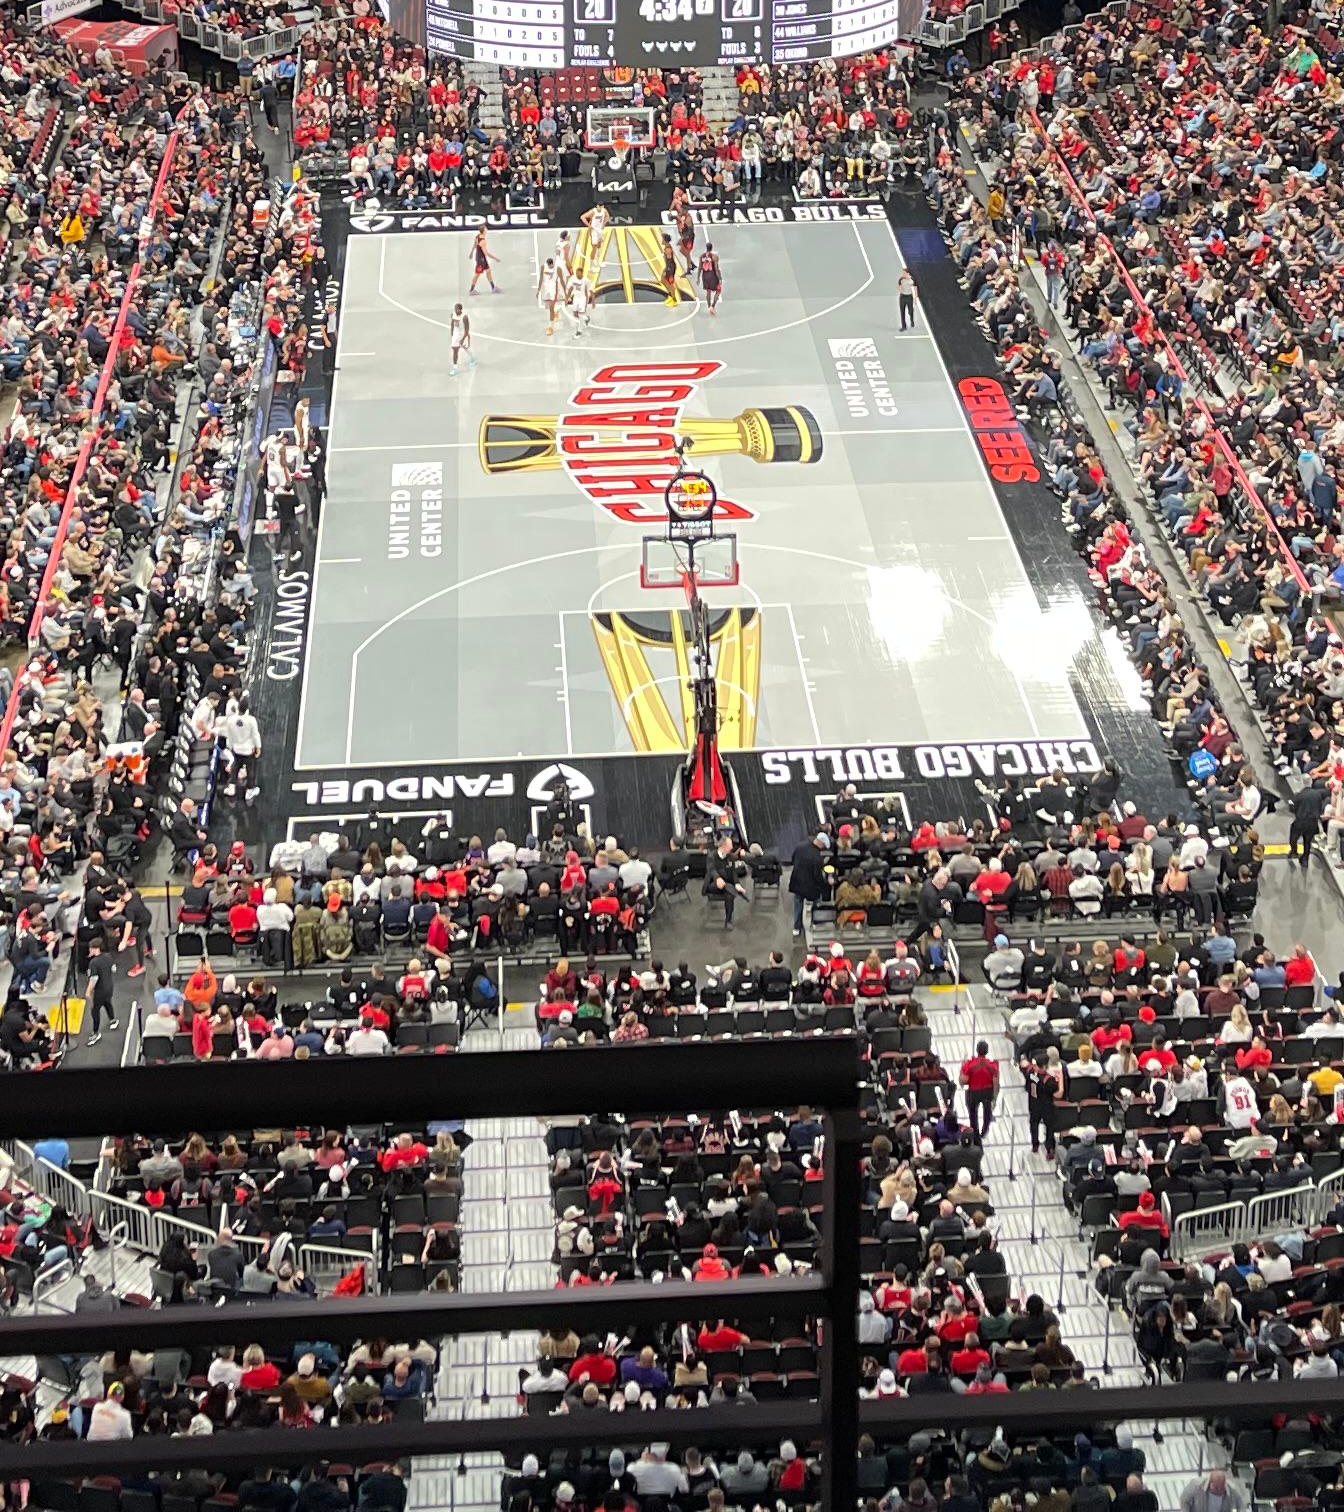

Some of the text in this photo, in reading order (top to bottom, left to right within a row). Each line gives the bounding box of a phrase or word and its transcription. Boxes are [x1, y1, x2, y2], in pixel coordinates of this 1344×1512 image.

[574, 44, 600, 57] FOULS
[721, 42, 746, 55] FOULS
[402, 214, 548, 228] FANDUEL
[792, 204, 887, 221] BULLS
[835, 360, 870, 417] UNITED
[863, 360, 898, 416] CENTER
[558, 360, 759, 525] CHICAGO
[958, 376, 1040, 483] SEE RED
[388, 489, 411, 559] UNITED
[420, 488, 442, 557] CENTER
[266, 569, 309, 681] CALAMOS
[292, 772, 515, 806] FANDUEL
[762, 741, 1103, 784] CHICAGO BULLS
